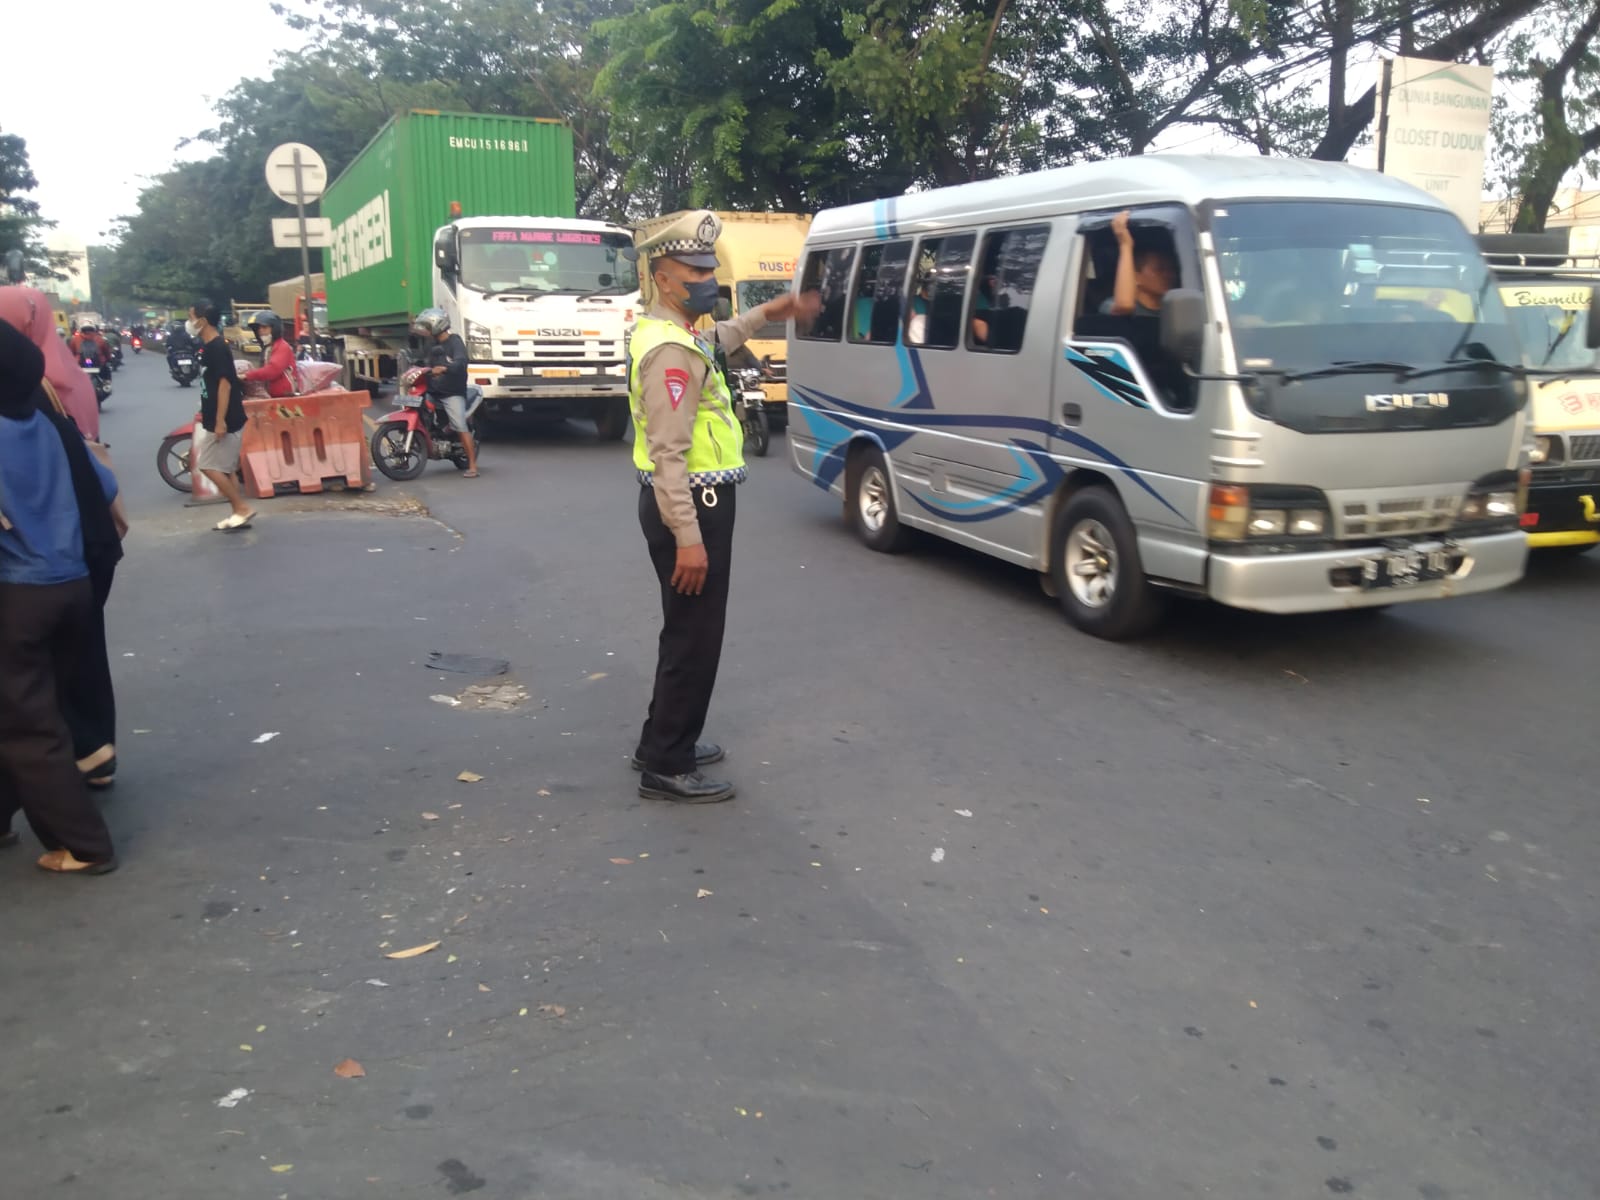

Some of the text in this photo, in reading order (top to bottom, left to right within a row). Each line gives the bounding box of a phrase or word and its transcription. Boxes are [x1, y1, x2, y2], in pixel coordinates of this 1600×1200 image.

[1432, 91, 1489, 111] BANGUNAN
[1393, 127, 1486, 152] CLOSET DUDUK
[537, 328, 582, 337] ISUZU
